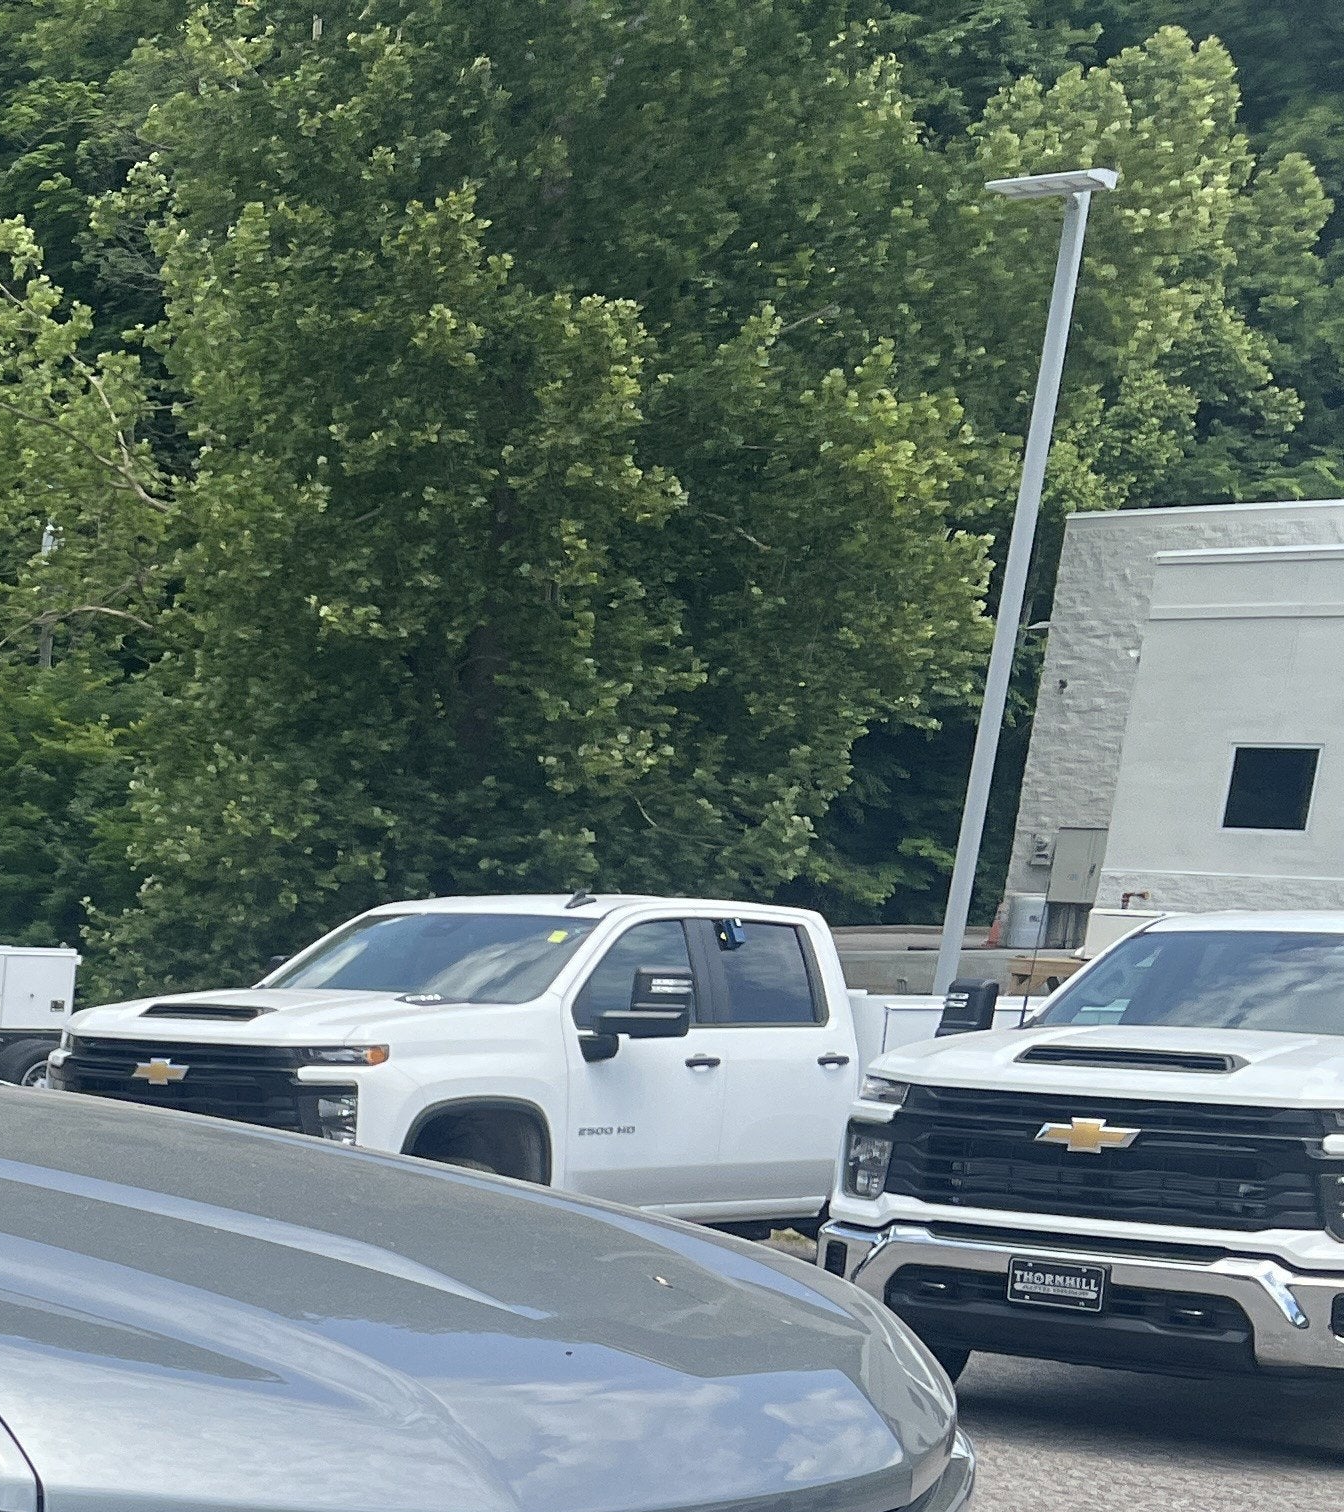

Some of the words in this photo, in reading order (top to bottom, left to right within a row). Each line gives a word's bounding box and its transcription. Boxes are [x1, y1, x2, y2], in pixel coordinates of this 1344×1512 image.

[578, 1126, 614, 1137] 2500
[616, 1125, 636, 1135] HD
[1013, 1269, 1099, 1292] THORNHILL
